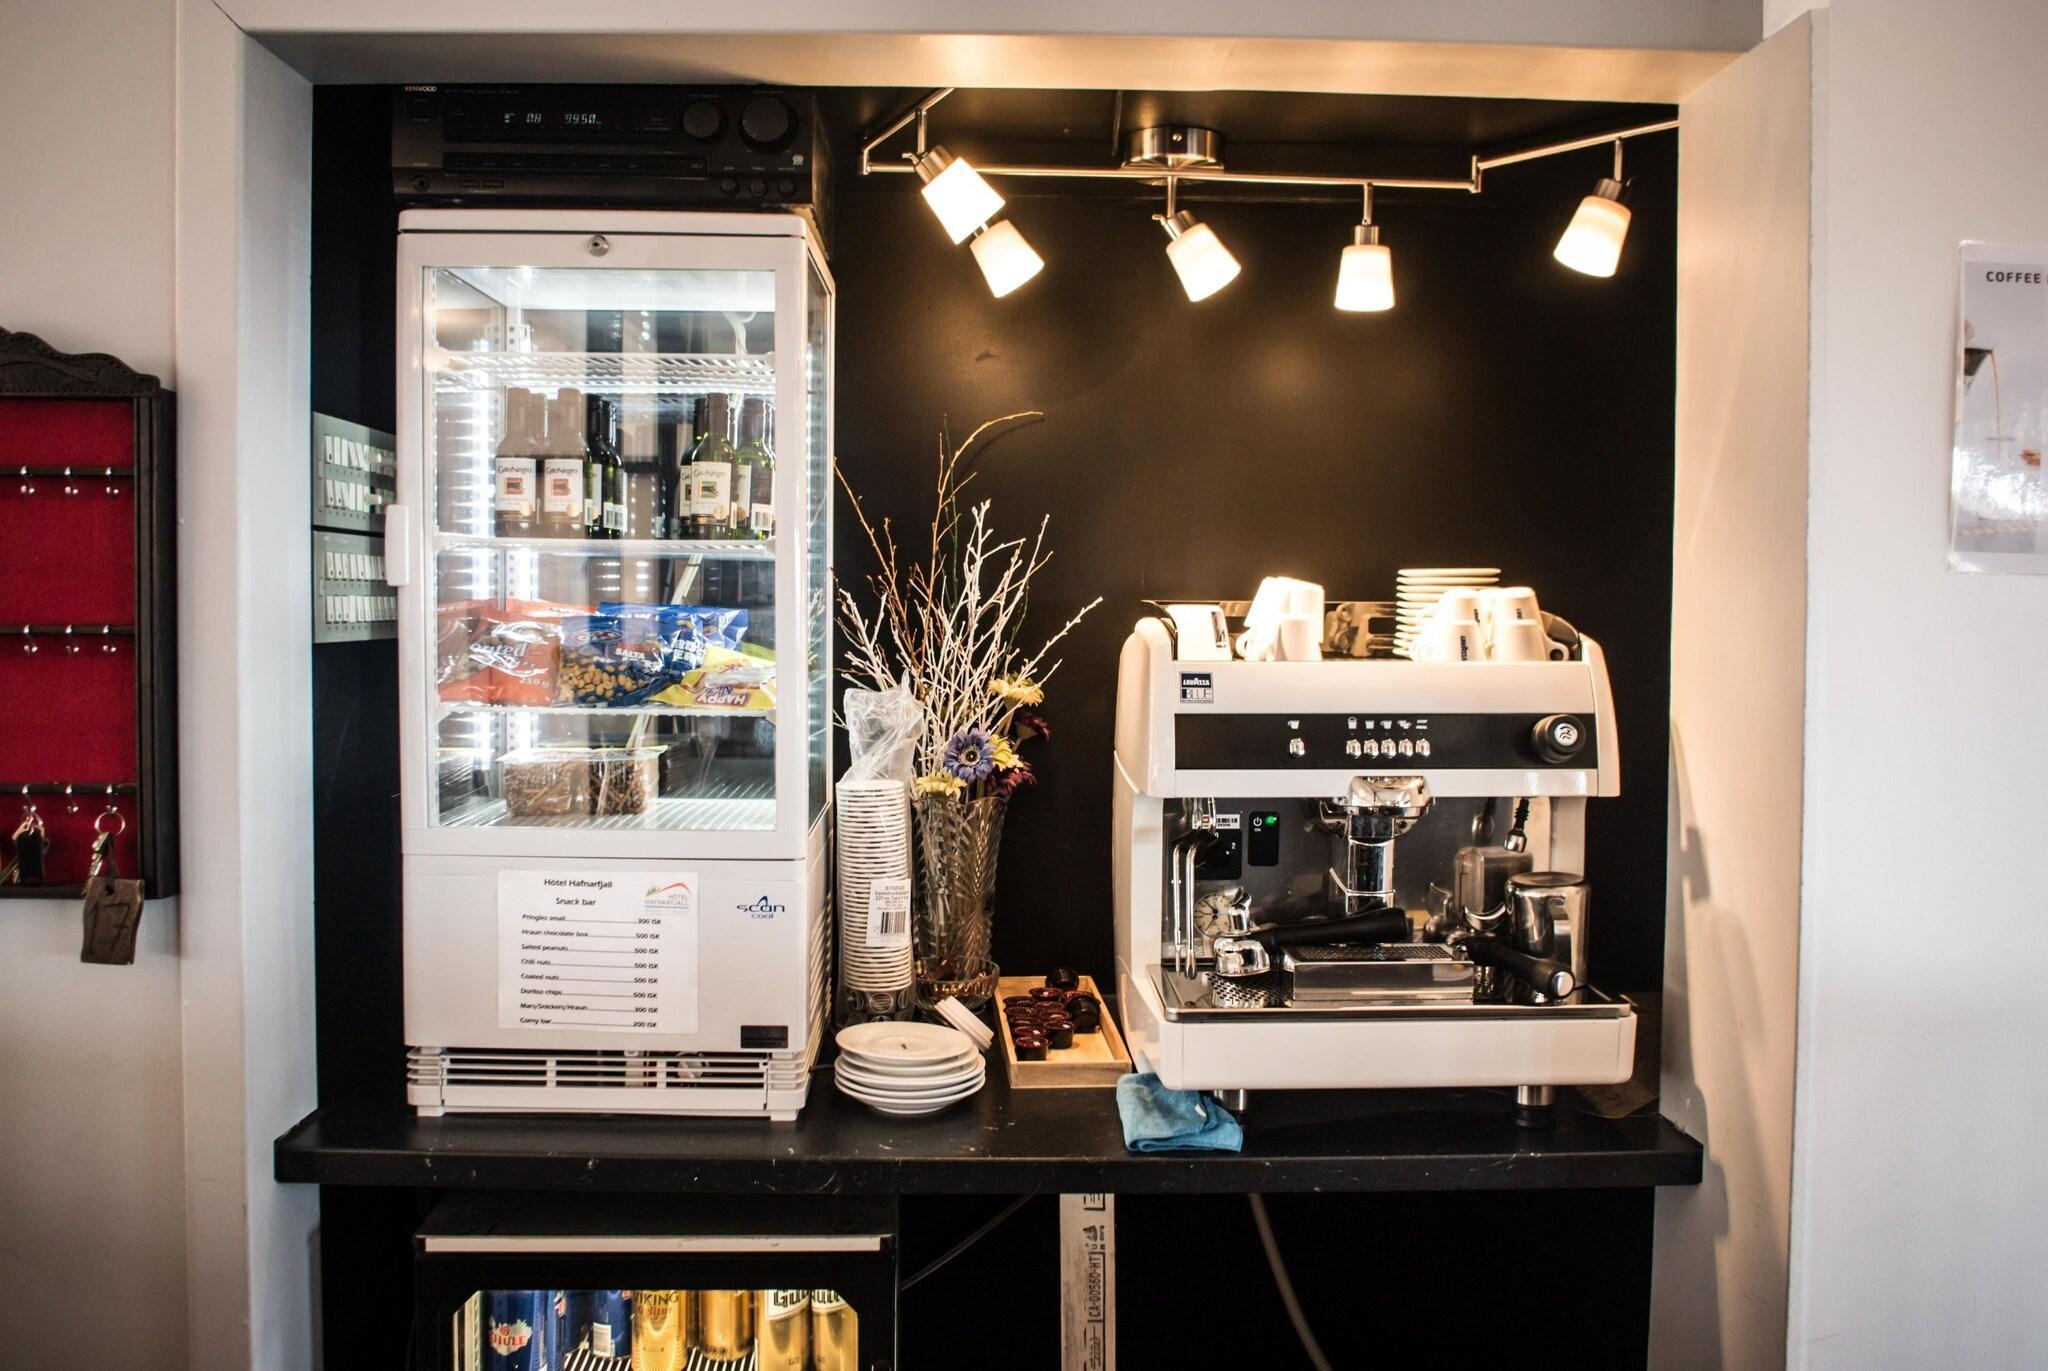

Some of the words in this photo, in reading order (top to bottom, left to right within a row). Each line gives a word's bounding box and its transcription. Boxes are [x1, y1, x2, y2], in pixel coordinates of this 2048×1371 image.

[1986, 271, 2041, 284] COFFEE
[1231, 842, 1237, 850] 2
[569, 879, 613, 890] Hafnarfjall
[556, 897, 579, 905] Snack
[582, 898, 597, 906] bar
[736, 895, 785, 913] scan
[520, 1017, 539, 1025] Corny
